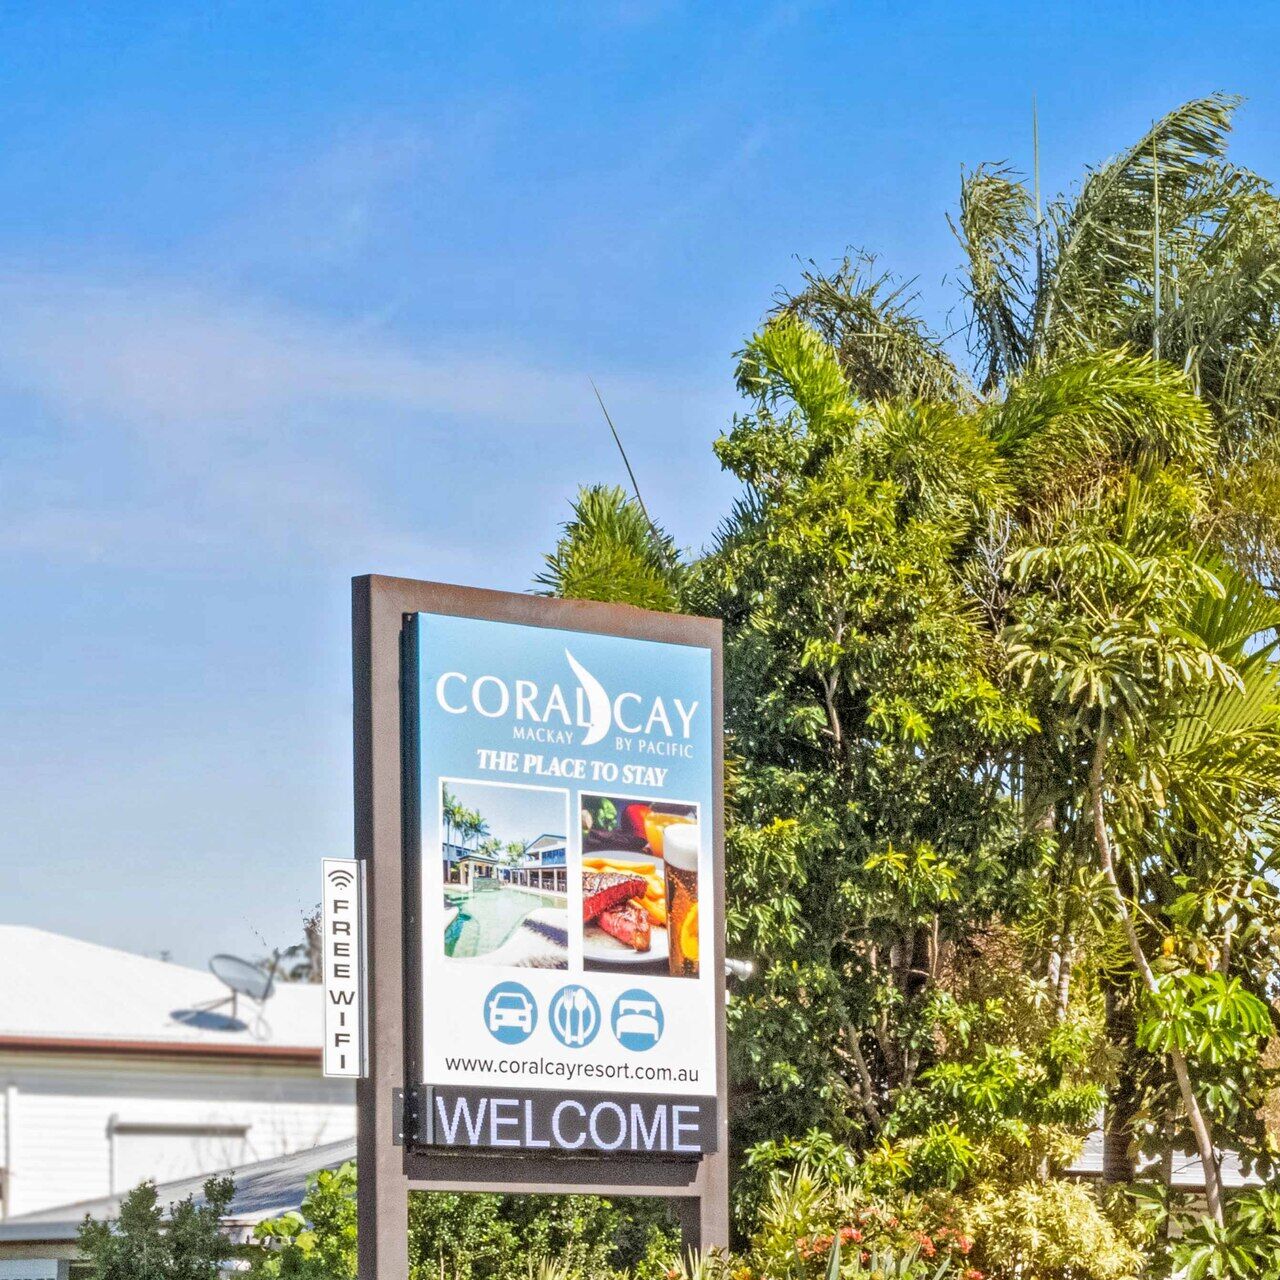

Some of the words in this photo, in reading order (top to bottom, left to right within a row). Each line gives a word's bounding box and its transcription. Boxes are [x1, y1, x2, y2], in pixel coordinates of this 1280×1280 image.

[436, 672, 593, 727] CORAL
[613, 693, 699, 738] CAY
[512, 726, 574, 745] MACKAY
[615, 736, 635, 752] BY
[638, 739, 694, 759] PACIFIC
[477, 749, 519, 773] THE
[523, 755, 587, 780] PLACE
[590, 761, 618, 783] TO
[622, 764, 668, 787] STAY
[332, 899, 351, 979] FREE
[329, 989, 355, 1070] WIFI
[444, 1056, 700, 1083] www.coralcayresort.com.au
[435, 1096, 701, 1151] WELCOME
